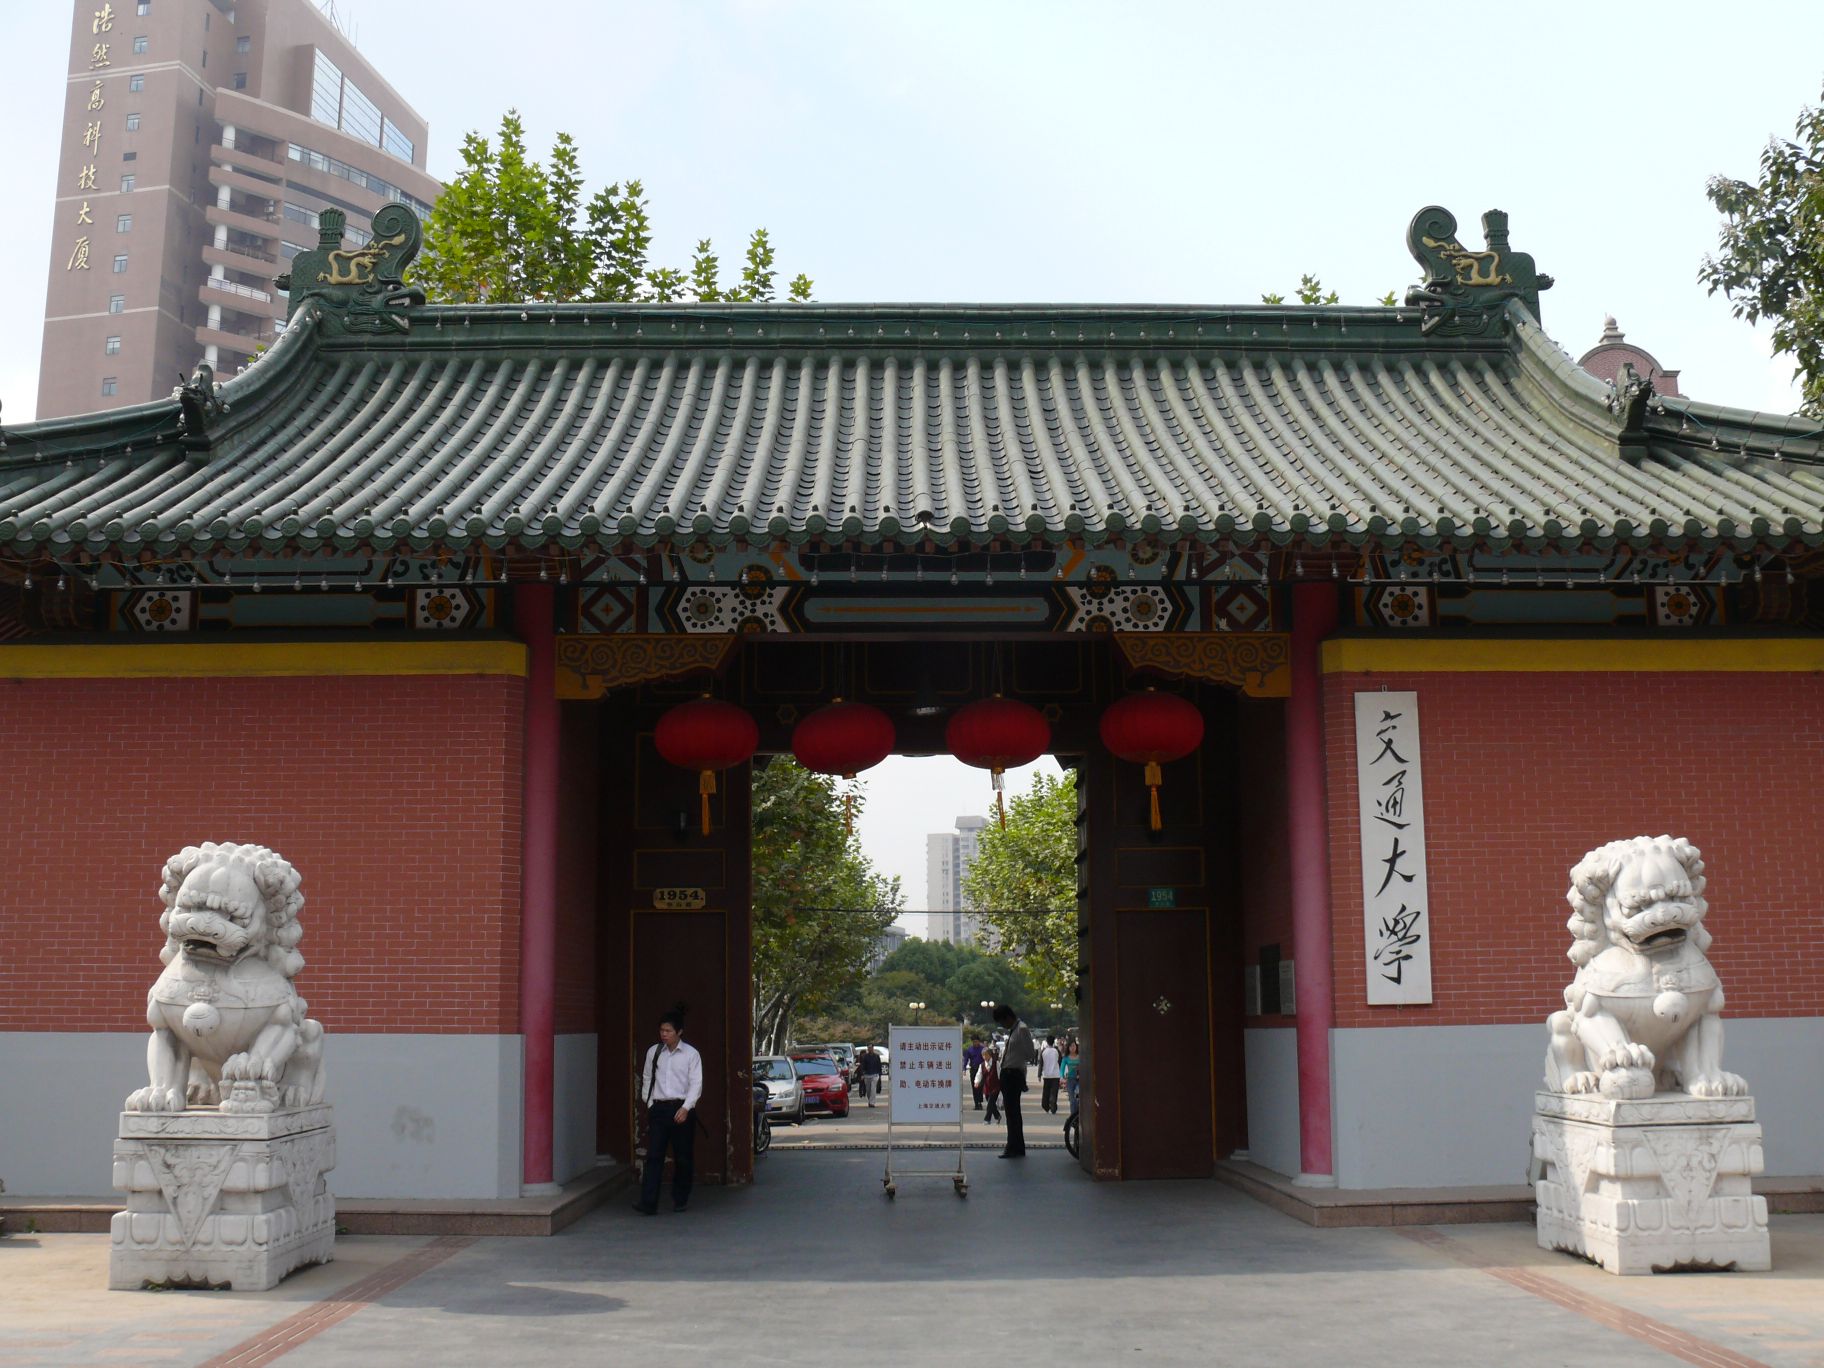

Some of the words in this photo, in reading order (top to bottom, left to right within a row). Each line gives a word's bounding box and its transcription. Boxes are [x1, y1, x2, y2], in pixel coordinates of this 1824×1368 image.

[67, 3, 115, 271] 浩然高科技大厦
[1369, 710, 1421, 985] 交通大學
[899, 1041, 953, 1051] 请主动出示证件
[899, 1061, 952, 1070] 禁止车辆进出
